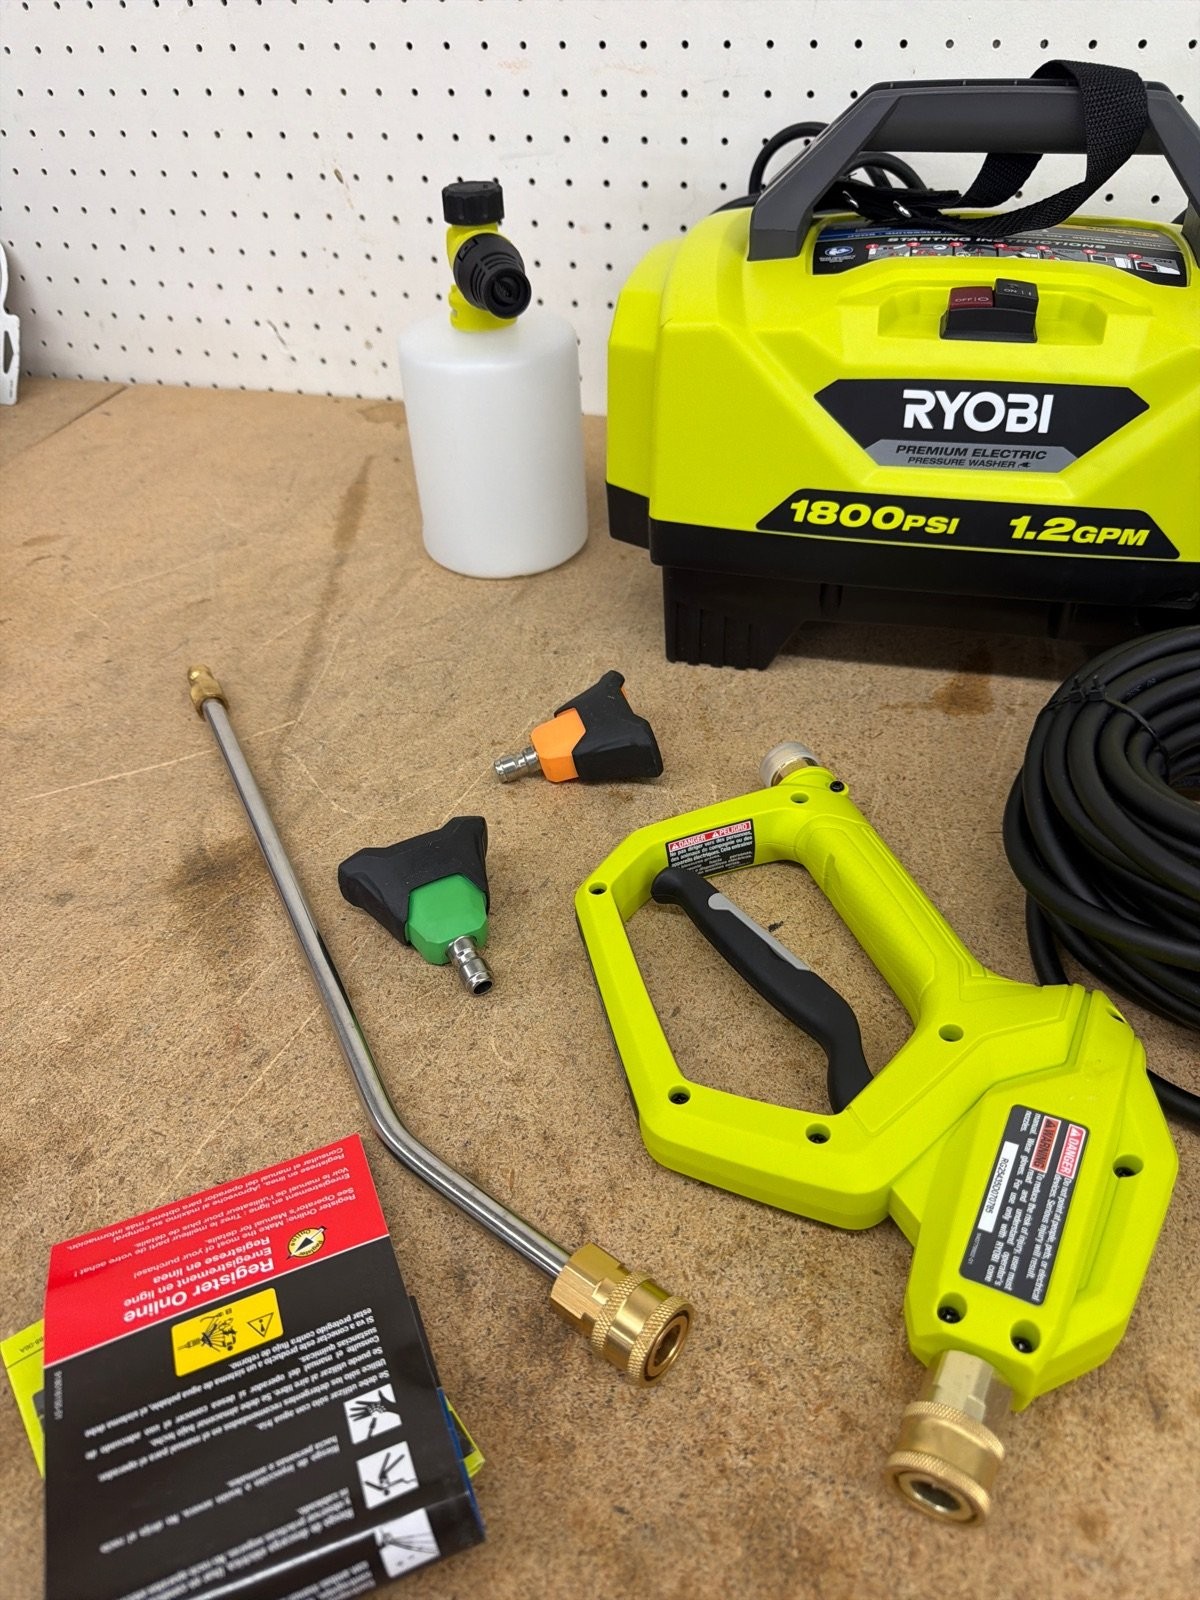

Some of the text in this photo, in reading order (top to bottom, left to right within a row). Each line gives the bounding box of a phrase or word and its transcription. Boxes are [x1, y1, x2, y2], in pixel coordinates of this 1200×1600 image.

[903, 389, 1054, 434] RYOBI
[895, 445, 1047, 460] PREMIUM ELECTRIC
[907, 456, 1015, 468] PRESSURE WASHER
[790, 499, 1150, 546] 1800PSI 1.2GPM
[679, 822, 748, 848] DANGER PELIGRO
[303, 1147, 343, 1166] Consultar
[1033, 1129, 1053, 1168] WARNING
[1060, 1137, 1079, 1174] DANGER
[260, 1167, 291, 1182] manual
[287, 1170, 299, 1178] en
[332, 1167, 349, 1176] Voir
[245, 1179, 259, 1188] del
[285, 1173, 350, 1201] Enregistrement
[288, 1177, 320, 1193] manuel
[204, 1184, 243, 1202] operador
[271, 1197, 283, 1205] en
[275, 1189, 287, 1197] de
[984, 1112, 1041, 1282] manual. Wear gloves. For use only with RYOBI cone
[182, 1198, 202, 1210] para
[226, 1194, 274, 1215] l'utilisateur
[248, 1202, 270, 1213] ligne
[146, 1207, 180, 1223] obtener
[165, 1206, 200, 1223] máximo
[203, 1211, 224, 1223] pour
[205, 1187, 354, 1244] See Operator's Manual for details.
[220, 1213, 242, 1224] Tirez
[125, 1220, 144, 1231] más
[168, 1228, 180, 1236] de
[172, 1224, 207, 1241] meilleur
[182, 1219, 201, 1230] plus
[994, 1168, 1034, 1286] read and understand operator's
[1004, 1173, 1046, 1291] To reduce the risk of injury, user must
[1026, 1173, 1063, 1279] devices. Serious injury will result.
[67, 1228, 123, 1250] información.
[113, 1225, 150, 1243] compra!
[133, 1193, 356, 1279] Register Online: Make the most of your purchase!
[134, 1233, 166, 1247] détails.
[1031, 1176, 1073, 1301] Do not point at people, pets, or electrical
[134, 1245, 147, 1255] de
[148, 1237, 170, 1250] parti
[108, 1252, 132, 1264] votre
[186, 1261, 202, 1271] en
[79, 1261, 107, 1275] achat
[123, 1246, 272, 1307] Enregistrement en ligne
[123, 1257, 274, 1322] Register Online
[355, 1319, 366, 1327] va
[365, 1315, 374, 1324] Si
[229, 1307, 372, 1369] estar protegido contra flujo de retorno.
[316, 1325, 349, 1343] conectar
[298, 1326, 377, 1362] sustancias químicas.
[298, 1339, 316, 1351] este
[263, 1345, 298, 1365] producto
[238, 1335, 380, 1399] Consulte el manual del operador si
[245, 1363, 257, 1373] un
[257, 1360, 263, 1368] a
[239, 1346, 383, 1411] Se puede utilizar al aire libre. Se debe
[282, 1358, 386, 1406] Utilice sólo los detergentes
[294, 1369, 390, 1414] Se debe utilizar sólo con
